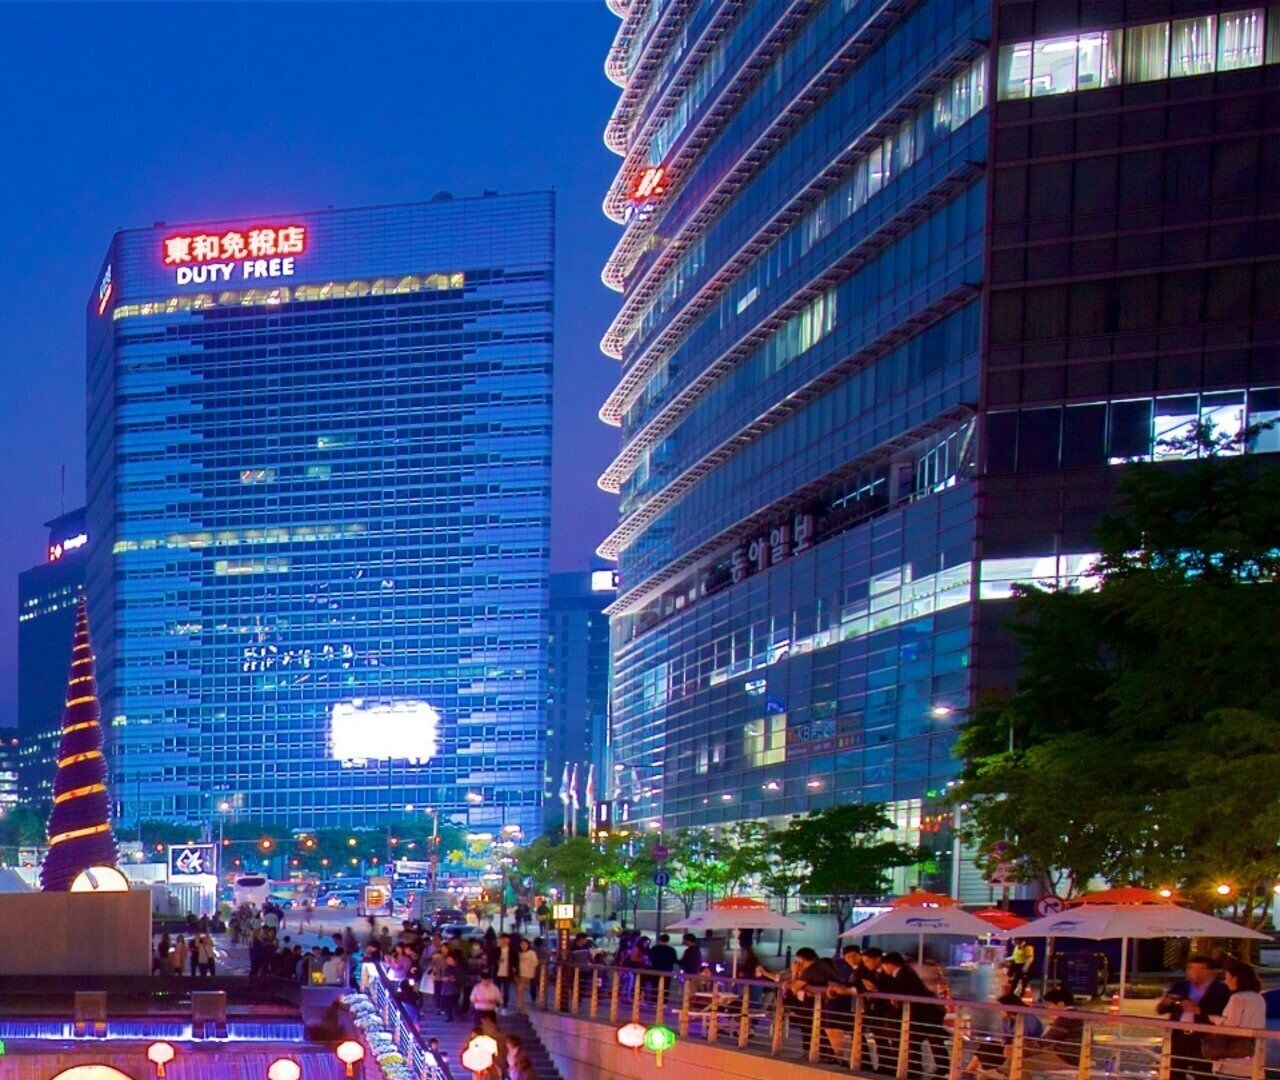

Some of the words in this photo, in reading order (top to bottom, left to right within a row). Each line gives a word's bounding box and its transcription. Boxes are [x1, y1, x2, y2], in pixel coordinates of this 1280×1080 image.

[176, 262, 235, 285] DUTY
[243, 257, 295, 279] FREE
[730, 514, 812, 583] 동아일보
